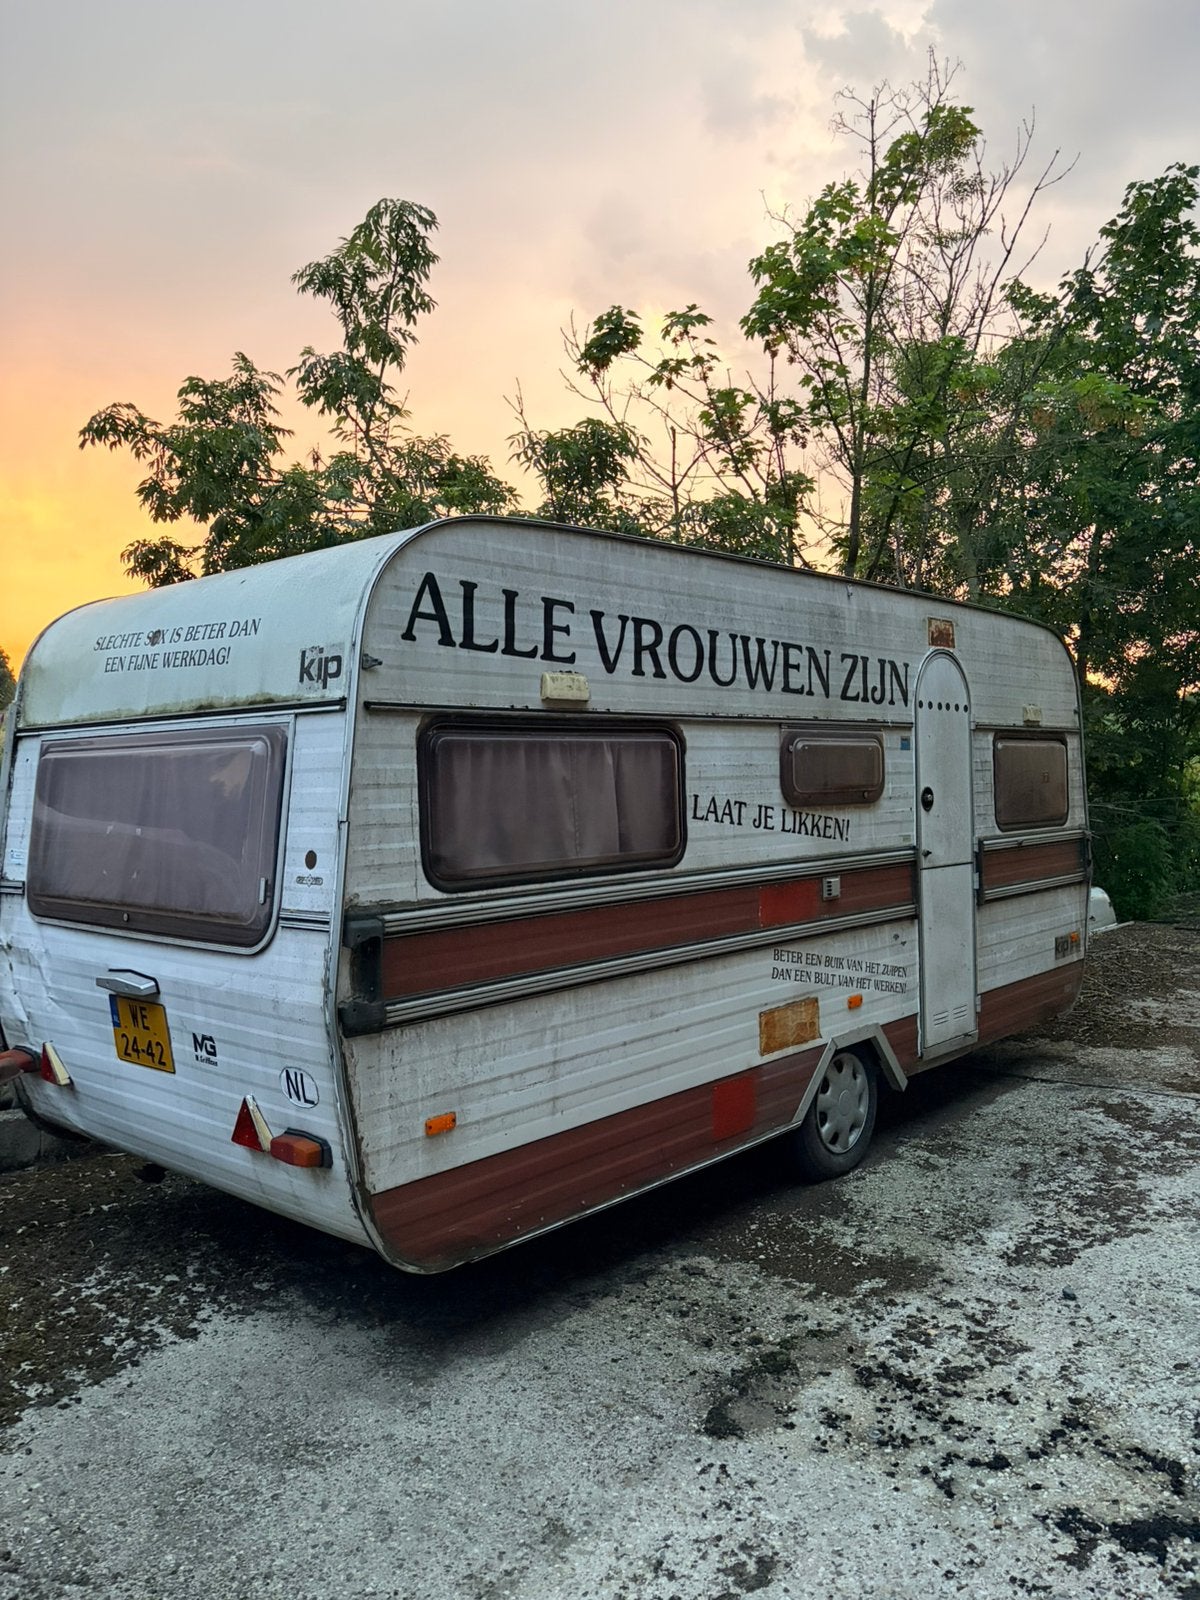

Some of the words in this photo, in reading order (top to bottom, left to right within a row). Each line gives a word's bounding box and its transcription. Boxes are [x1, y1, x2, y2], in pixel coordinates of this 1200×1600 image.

[93, 631, 145, 651] SLECHTE
[144, 628, 169, 647] SX
[169, 627, 183, 643] IS
[184, 622, 227, 642] BETER
[228, 617, 262, 638] DAN
[401, 571, 576, 664] ALLE
[589, 609, 831, 699] VROUWEN
[840, 652, 910, 707] ZIJN
[104, 655, 127, 673] EEN
[127, 652, 161, 671] FIJNE
[162, 646, 231, 668] WERKDAG!
[299, 650, 342, 689] kip
[691, 794, 748, 826] LAAT
[752, 804, 775, 830] JE
[780, 808, 851, 842] LIKKEN!
[771, 966, 792, 981] DAN
[794, 969, 812, 983] EEN
[814, 971, 837, 986] BULT
[838, 974, 855, 988] VAN
[855, 977, 872, 990] HET
[873, 978, 907, 994] WERKEN!
[773, 948, 803, 964] BETER
[805, 952, 823, 966] EEN
[824, 955, 845, 970] BUIK
[846, 958, 863, 972] VAN
[864, 961, 881, 975] HET
[881, 963, 908, 978] ZUIPEN
[128, 1003, 150, 1031] WE
[121, 1033, 167, 1067] 24-42
[285, 1069, 315, 1105] NL
